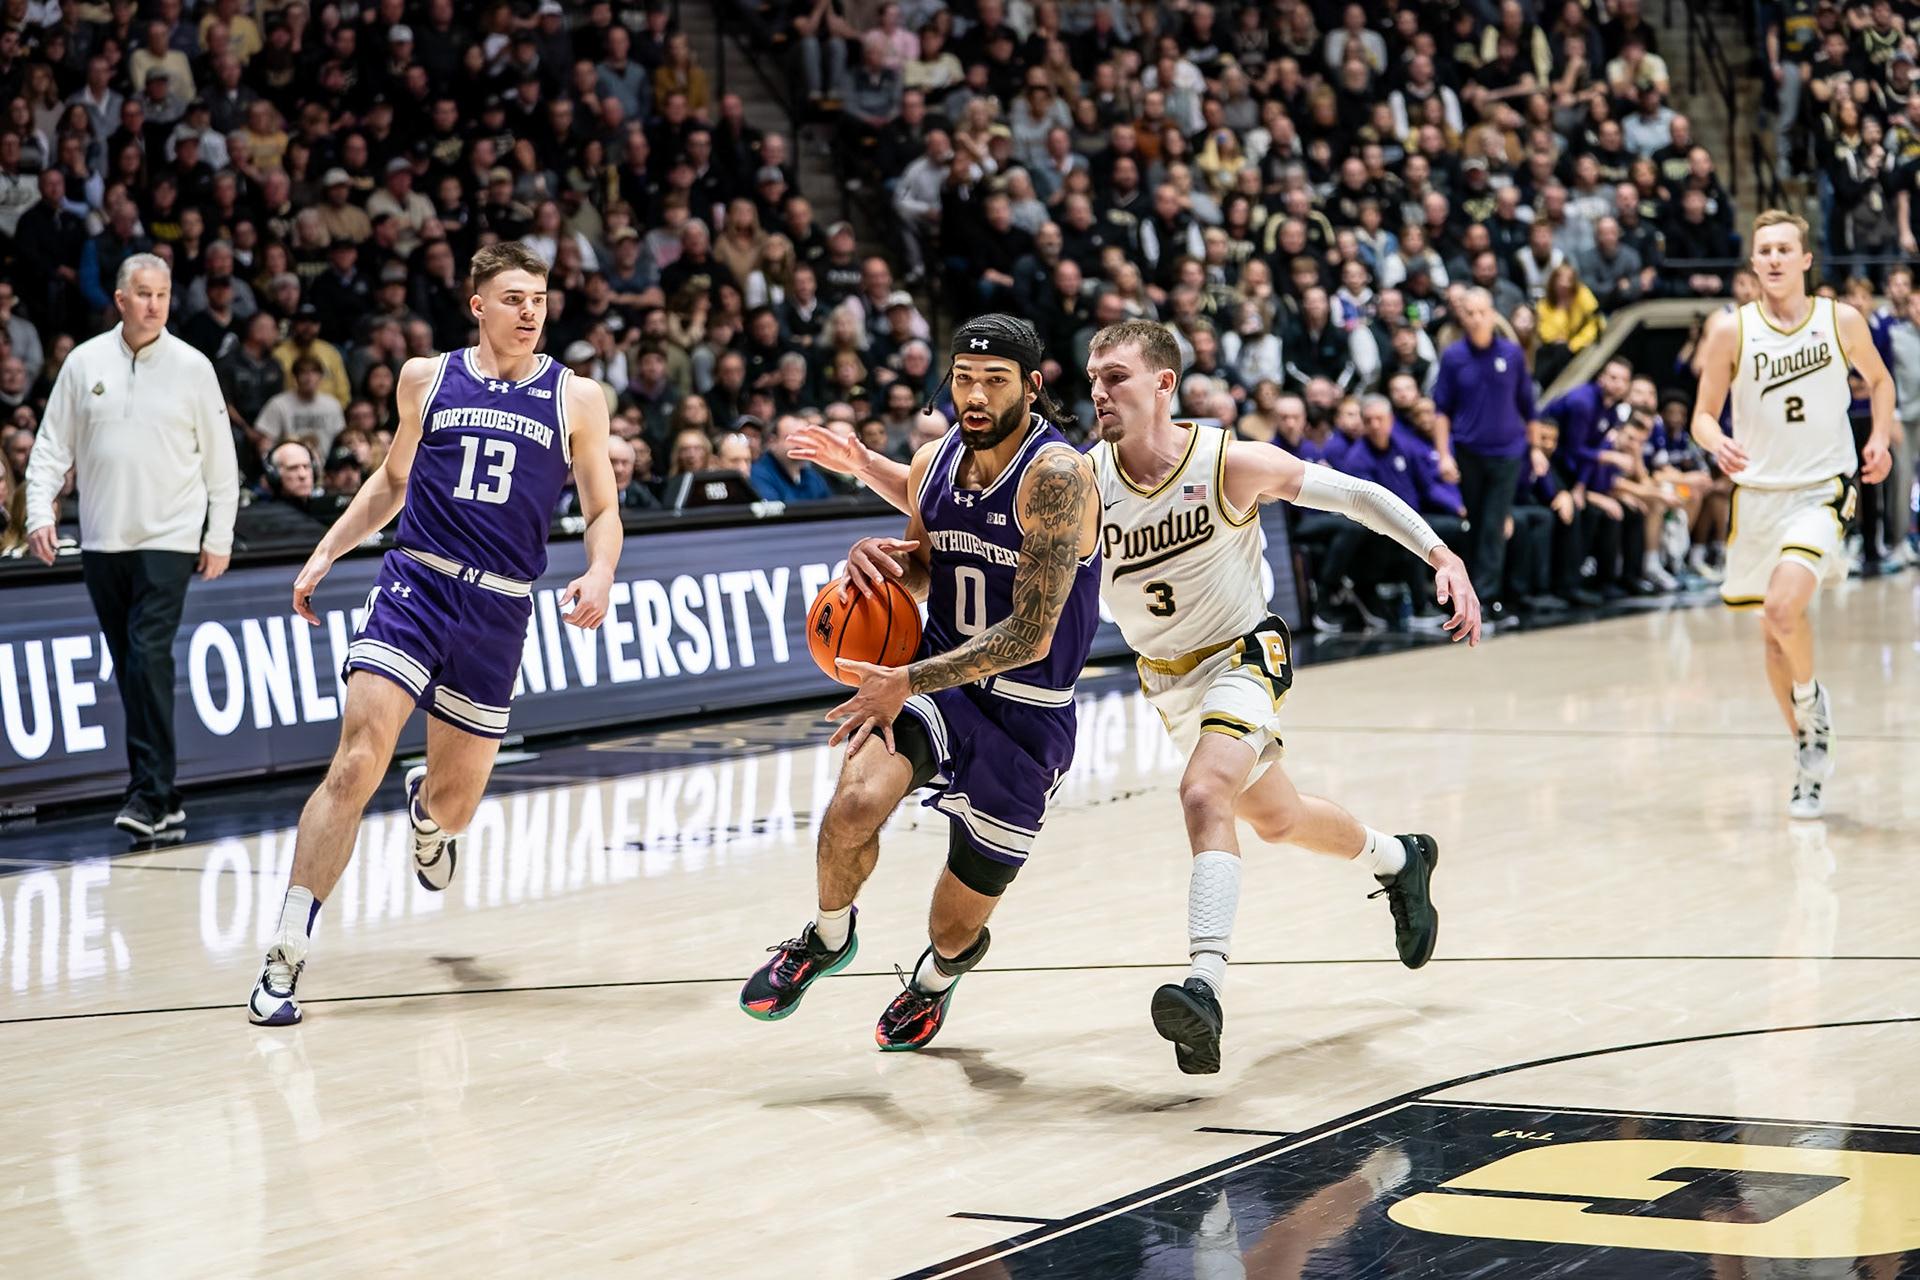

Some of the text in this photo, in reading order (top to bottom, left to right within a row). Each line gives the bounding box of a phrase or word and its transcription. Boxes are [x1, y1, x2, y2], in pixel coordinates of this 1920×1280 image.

[1753, 342, 1832, 381] Purdue
[431, 407, 555, 450] NORTHWESTERN
[1784, 396, 1805, 424] 2
[452, 435, 517, 505] 13
[1102, 504, 1215, 560] Purdue
[463, 567, 480, 584] N
[954, 565, 987, 636] 0
[1143, 579, 1176, 617] 3
[815, 602, 834, 648] P
[1020, 622, 1038, 642] TO
[188, 607, 365, 736] ONLI
[514, 566, 791, 696] NIVERSITY
[1254, 630, 1288, 678] P
